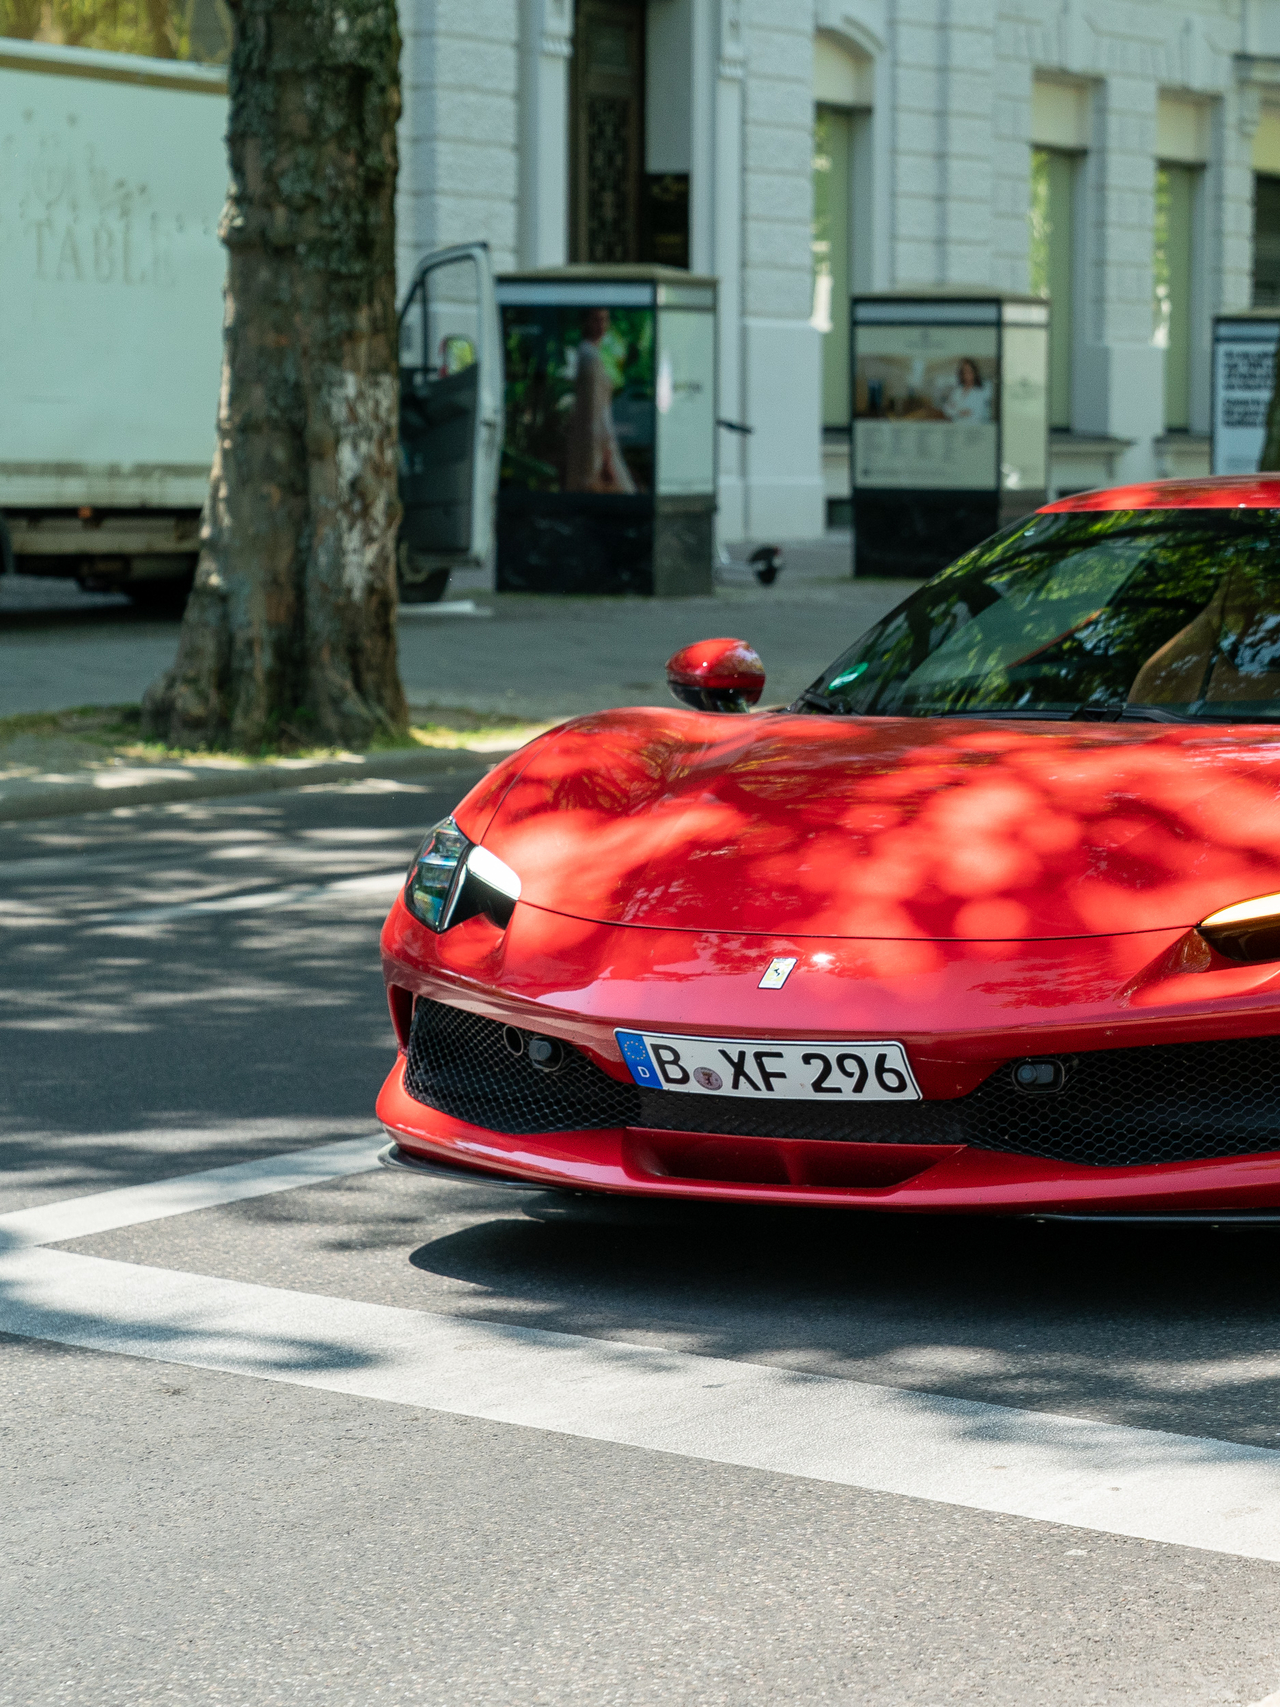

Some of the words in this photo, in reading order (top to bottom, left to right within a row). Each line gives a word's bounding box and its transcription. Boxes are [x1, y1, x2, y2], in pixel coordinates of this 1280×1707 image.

[638, 1066, 650, 1078] D
[650, 1043, 690, 1084] B
[718, 1049, 787, 1091] XF
[802, 1052, 907, 1093] 296
